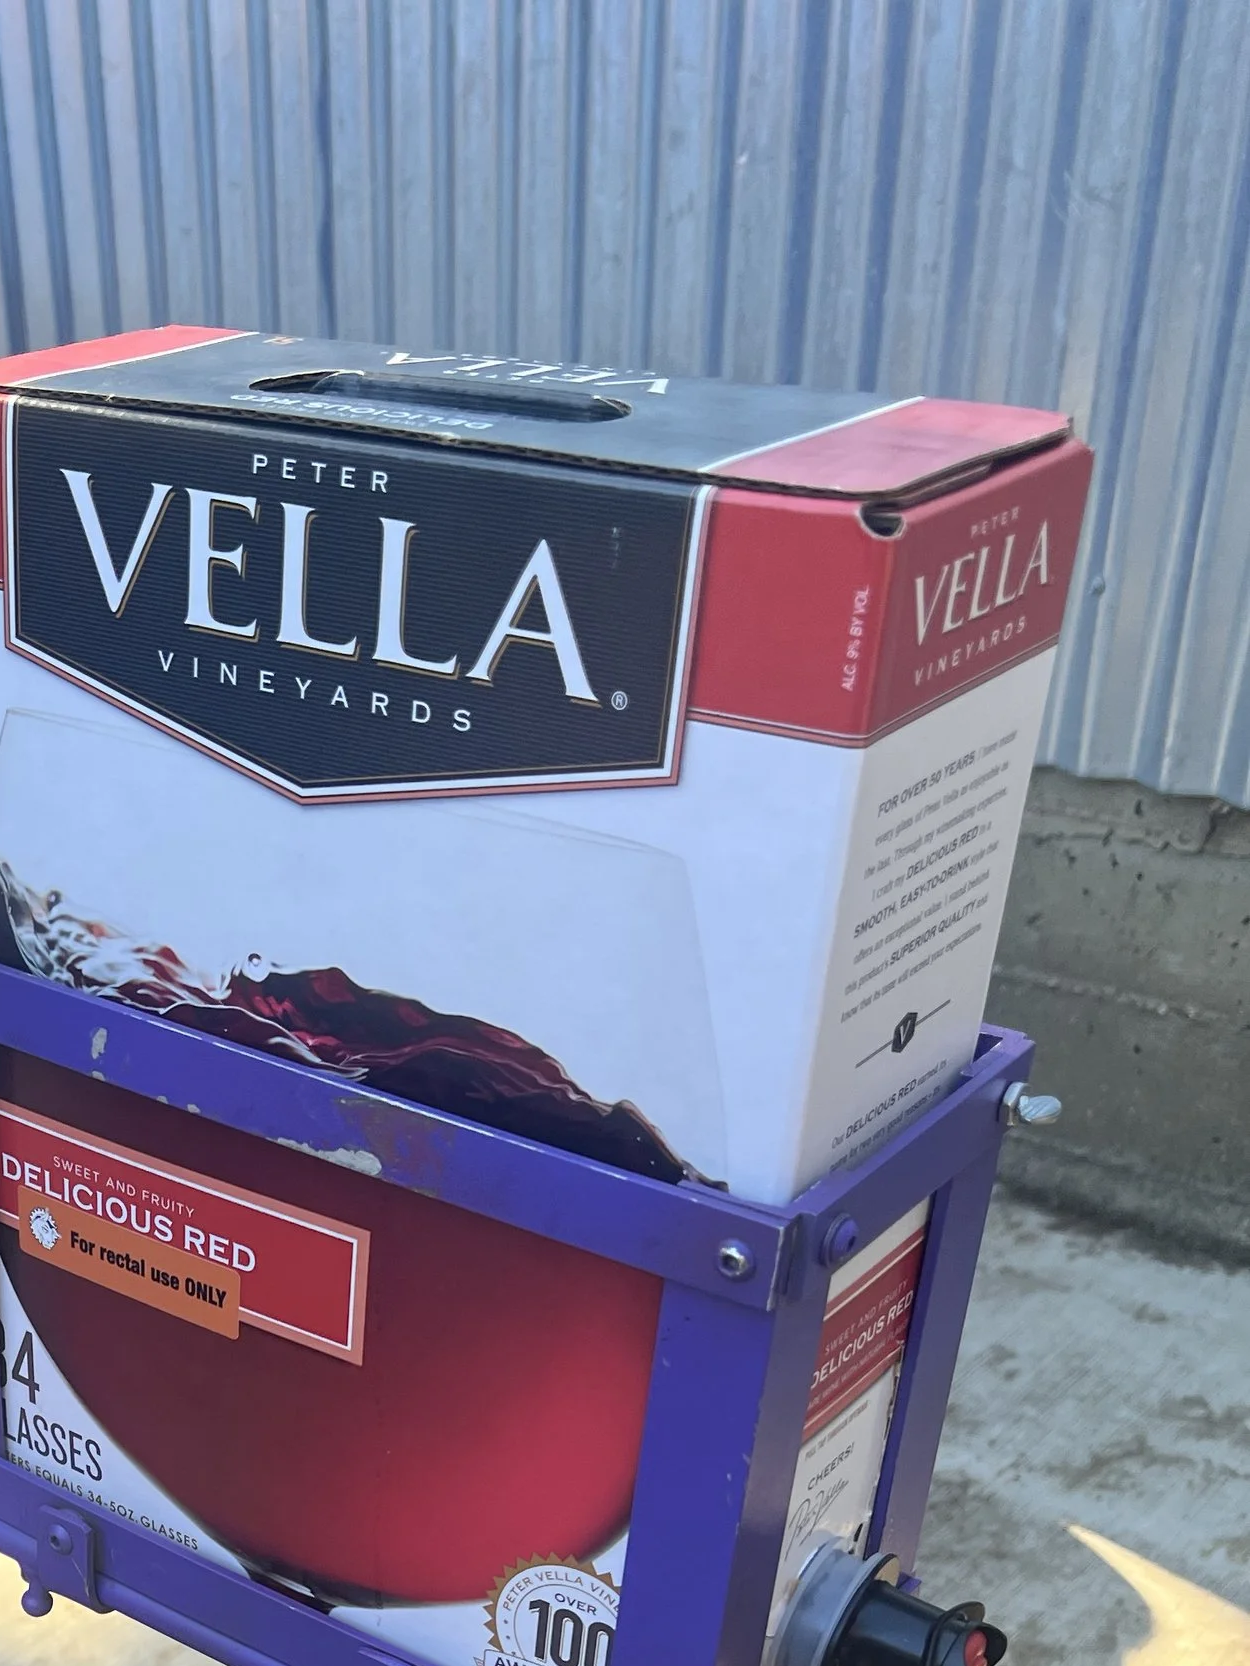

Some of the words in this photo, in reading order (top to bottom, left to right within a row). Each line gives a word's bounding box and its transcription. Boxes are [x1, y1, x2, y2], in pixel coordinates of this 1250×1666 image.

[387, 352, 670, 394] VELLA
[228, 394, 302, 408] RED
[304, 401, 494, 430] DELICIOUS
[252, 453, 390, 494] PETER
[970, 506, 1021, 539] PETER
[915, 519, 1048, 647] VELLA
[850, 615, 865, 637] BY
[914, 615, 1027, 687] VINEYARDS
[158, 649, 472, 732] VINEYARDS
[877, 794, 899, 818] FOR
[900, 777, 928, 805] OVER
[905, 838, 958, 881] DELICIOUS
[958, 824, 979, 849] RED
[900, 855, 970, 910] EASY-TO-DRINK
[889, 925, 938, 967] SUPERIOR
[937, 898, 977, 934] QUALITY
[845, 1092, 897, 1140] DELICIOUS
[897, 1078, 917, 1101] RED
[1, 1151, 174, 1246] DELICIOUS
[183, 1225, 257, 1273] RED
[52, 1154, 101, 1184] SWEET
[105, 1174, 137, 1199] AND
[141, 1188, 196, 1220] FRUITY
[70, 1230, 96, 1258] For
[99, 1244, 146, 1279] rectal
[150, 1264, 181, 1292] use
[184, 1277, 228, 1310] ONLY
[886, 1289, 914, 1326] RED
[1, 1397, 104, 1482] LASSES
[807, 1441, 855, 1491] CHEERS!
[35, 1464, 85, 1498] EQUALS
[139, 1514, 200, 1552] GLASSES
[502, 1577, 534, 1612] PETER
[535, 1570, 584, 1587] VELLA
[554, 1592, 597, 1616] OVER
